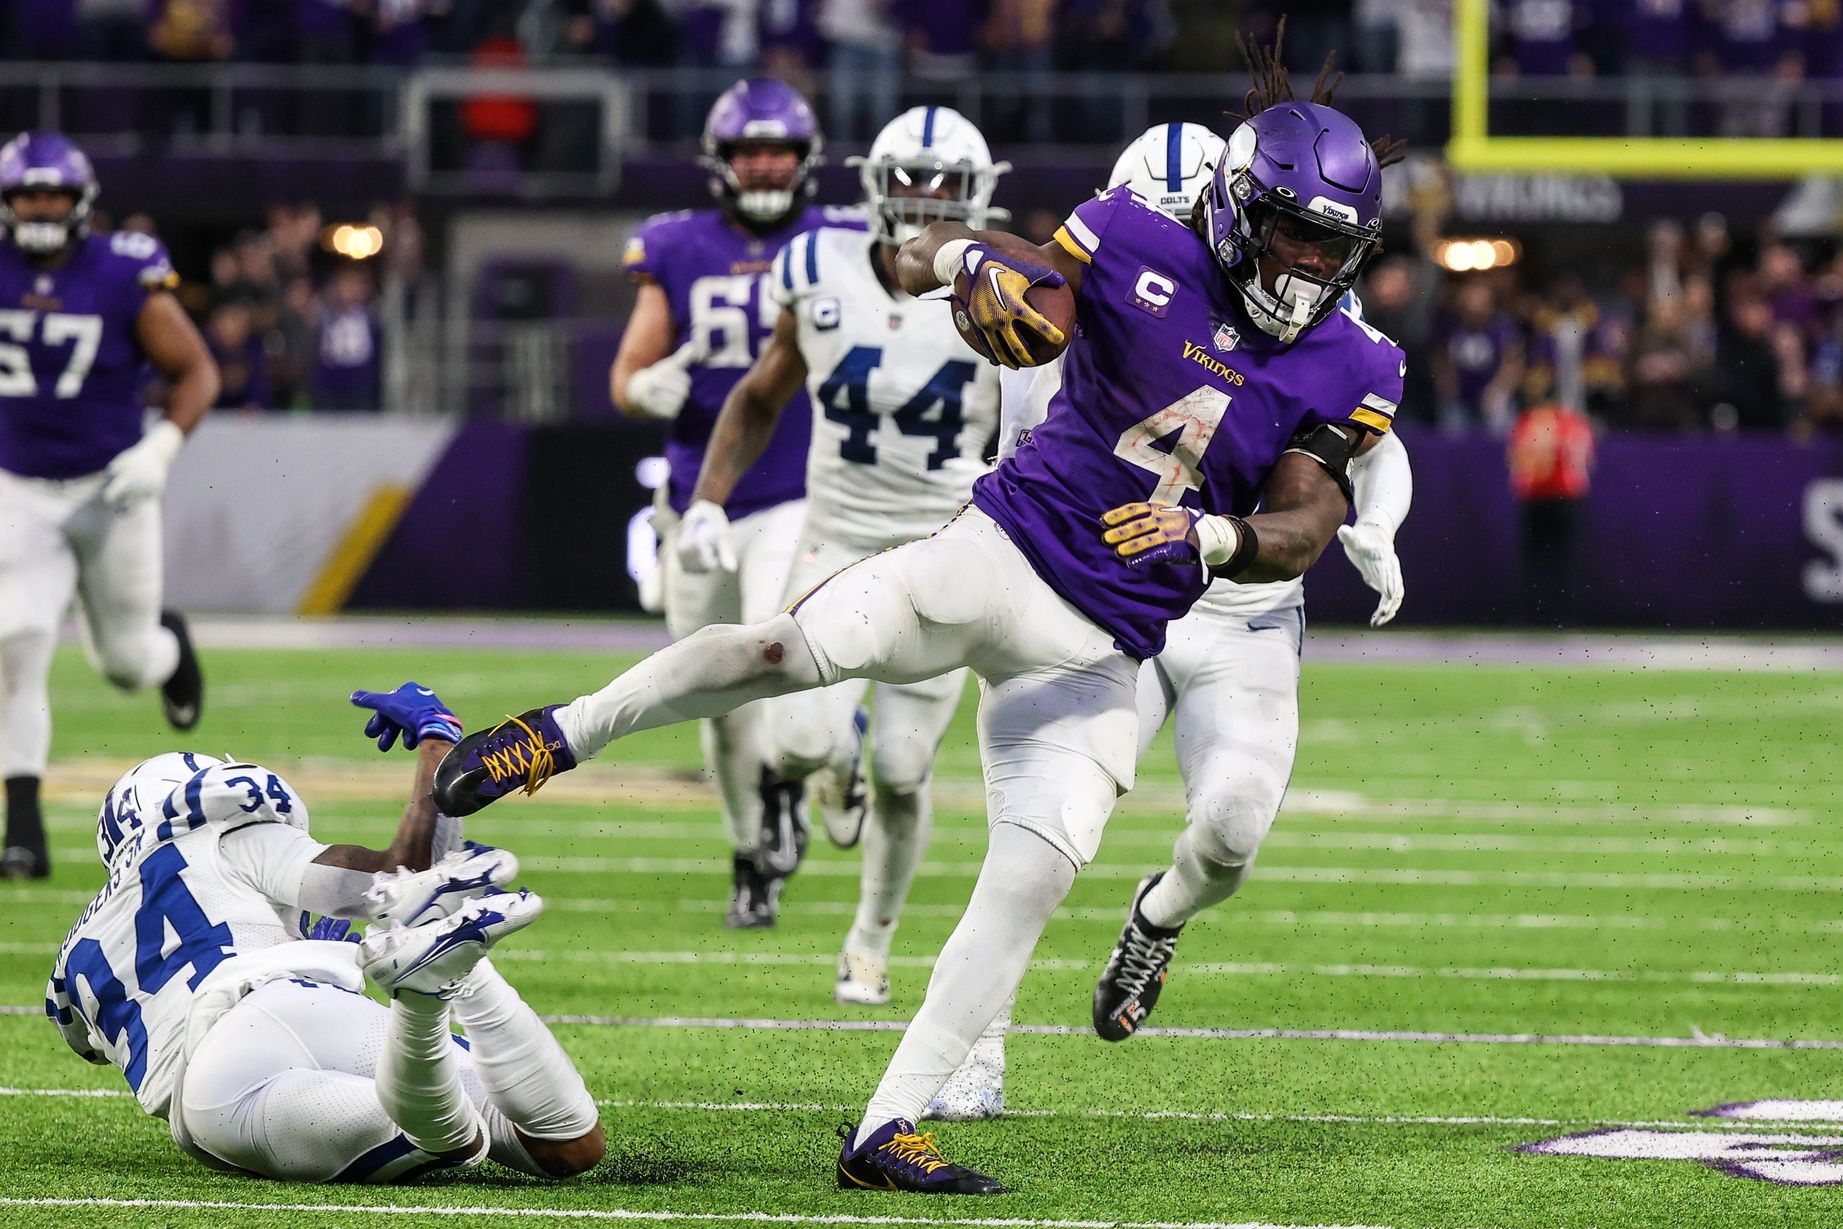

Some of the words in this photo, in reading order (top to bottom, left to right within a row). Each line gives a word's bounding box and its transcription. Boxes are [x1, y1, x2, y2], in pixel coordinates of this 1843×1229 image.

[1160, 196, 1190, 205] COLTS
[1135, 271, 1175, 307] C
[818, 345, 977, 471] 44
[1113, 384, 1233, 507] 4
[225, 774, 293, 815] 34
[64, 841, 238, 1098] 34
